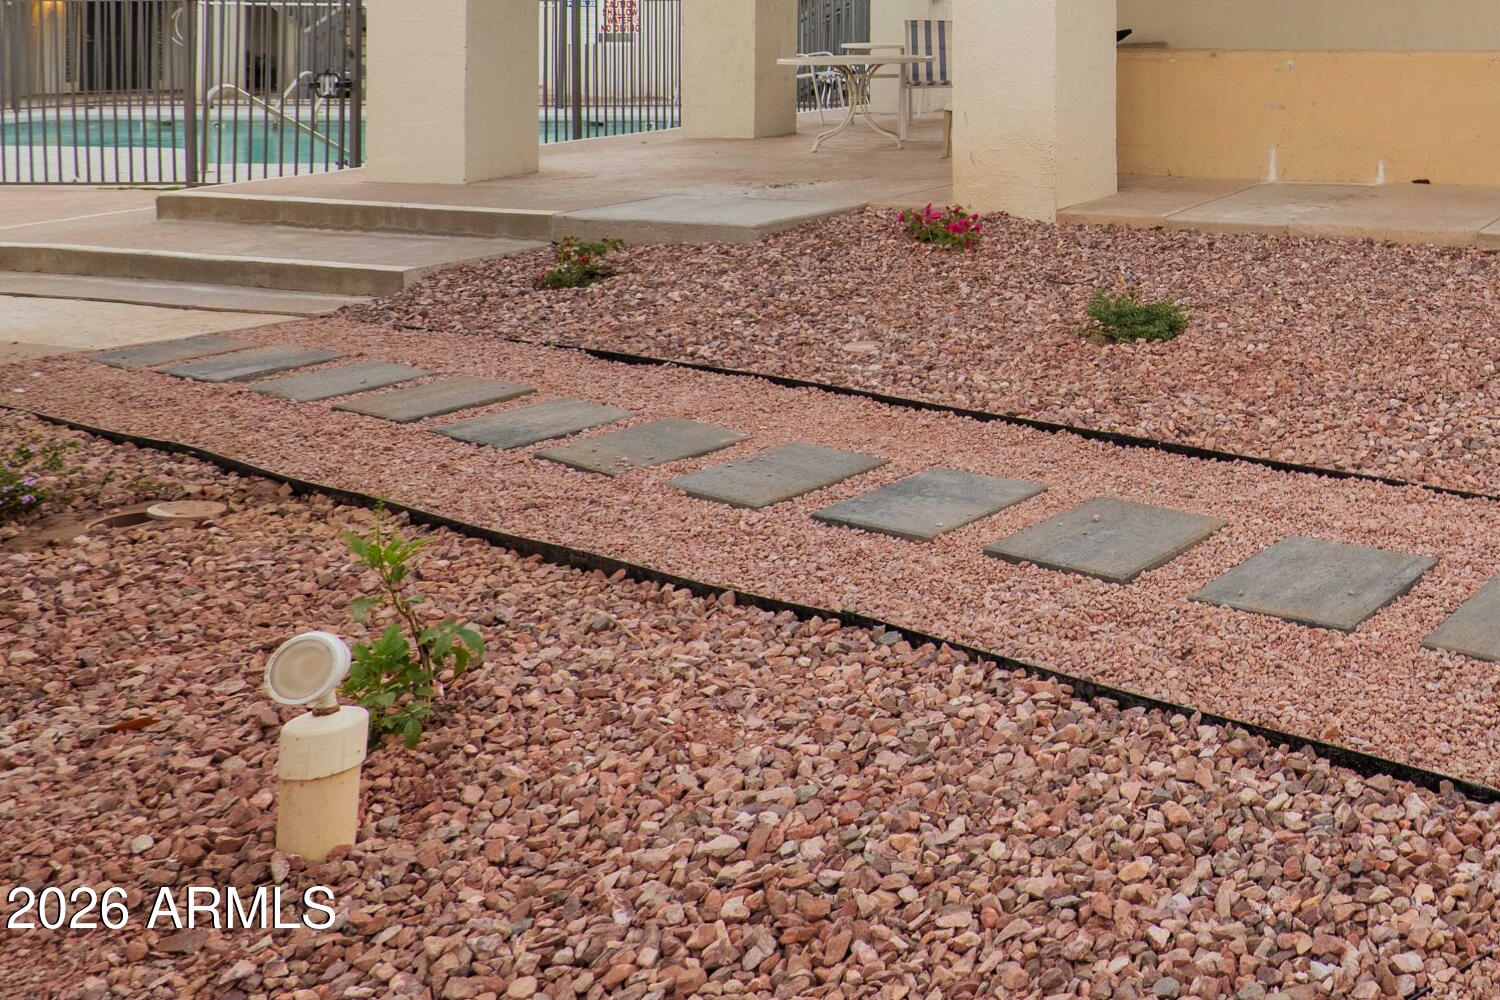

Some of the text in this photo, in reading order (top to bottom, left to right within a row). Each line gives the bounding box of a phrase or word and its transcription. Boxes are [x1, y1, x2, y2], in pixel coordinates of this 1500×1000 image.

[602, 8, 637, 16] SHALLOW
[601, 24, 641, 32] NO DIVING
